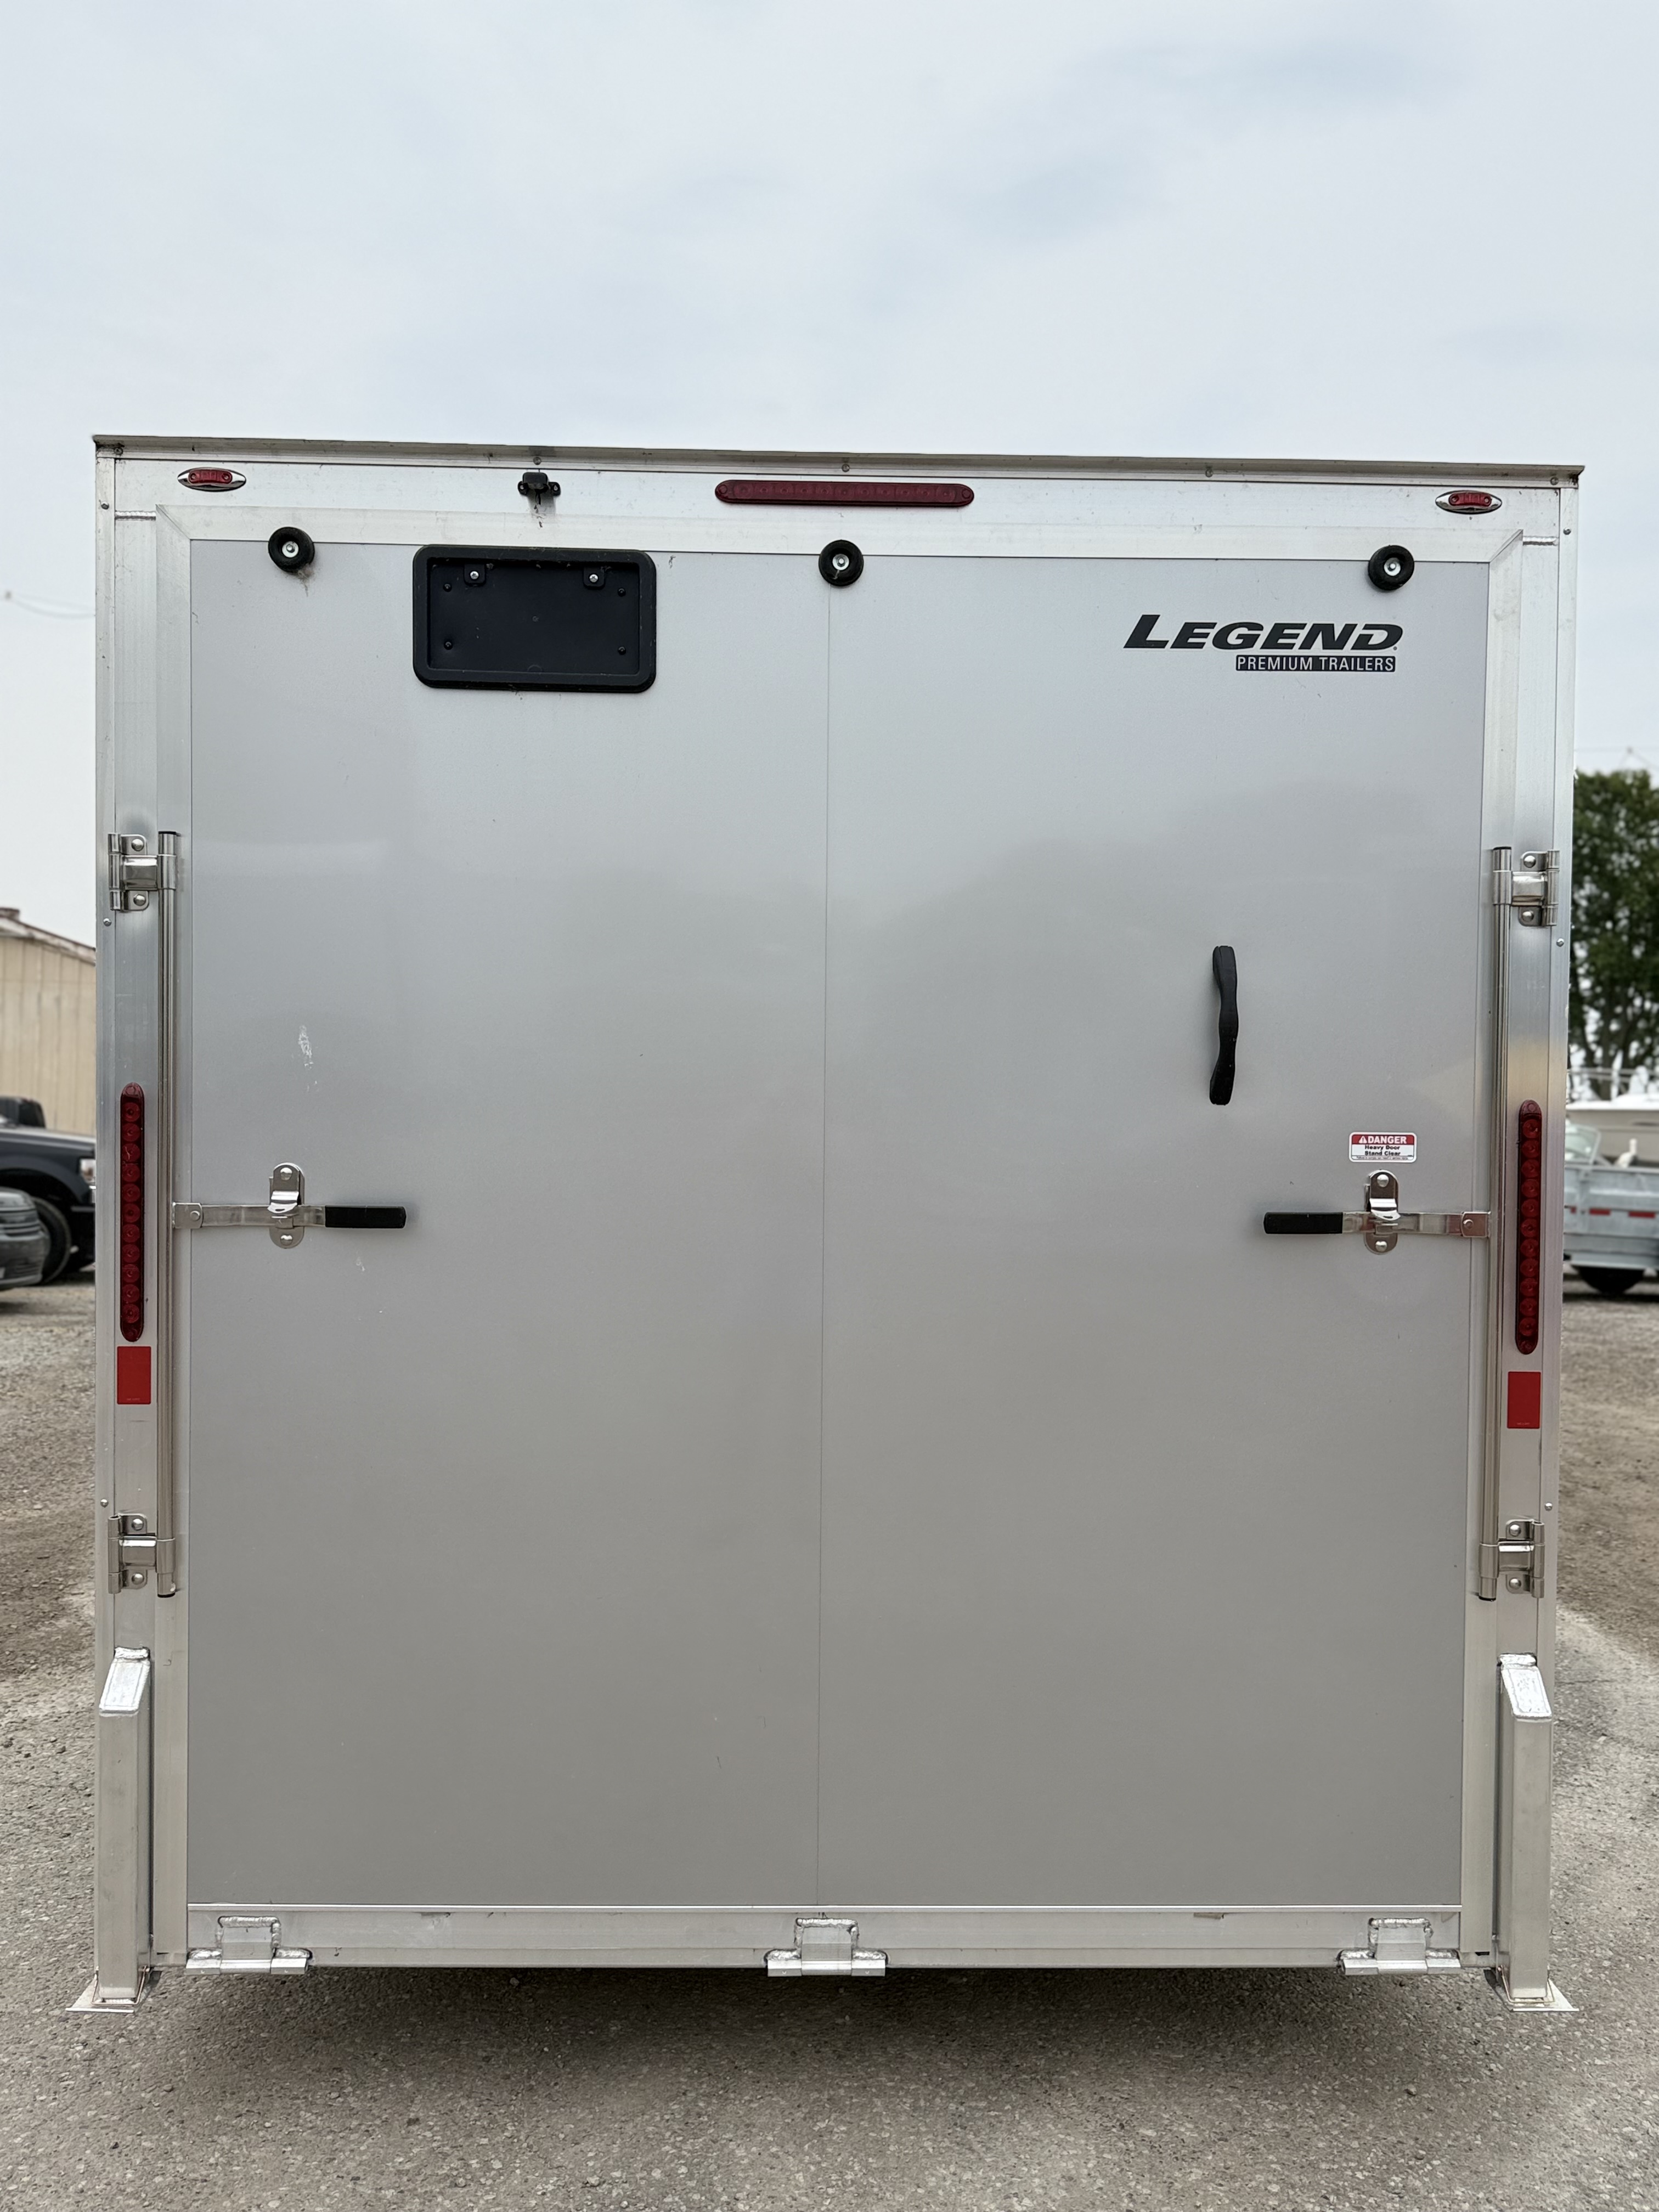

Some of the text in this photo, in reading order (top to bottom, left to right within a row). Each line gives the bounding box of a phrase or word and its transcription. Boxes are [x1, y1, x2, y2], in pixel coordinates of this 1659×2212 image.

[1123, 614, 1403, 651] LEGEND
[1238, 657, 1393, 671] PREMIUM TRAILERS
[1368, 1136, 1407, 1144] DANGER
